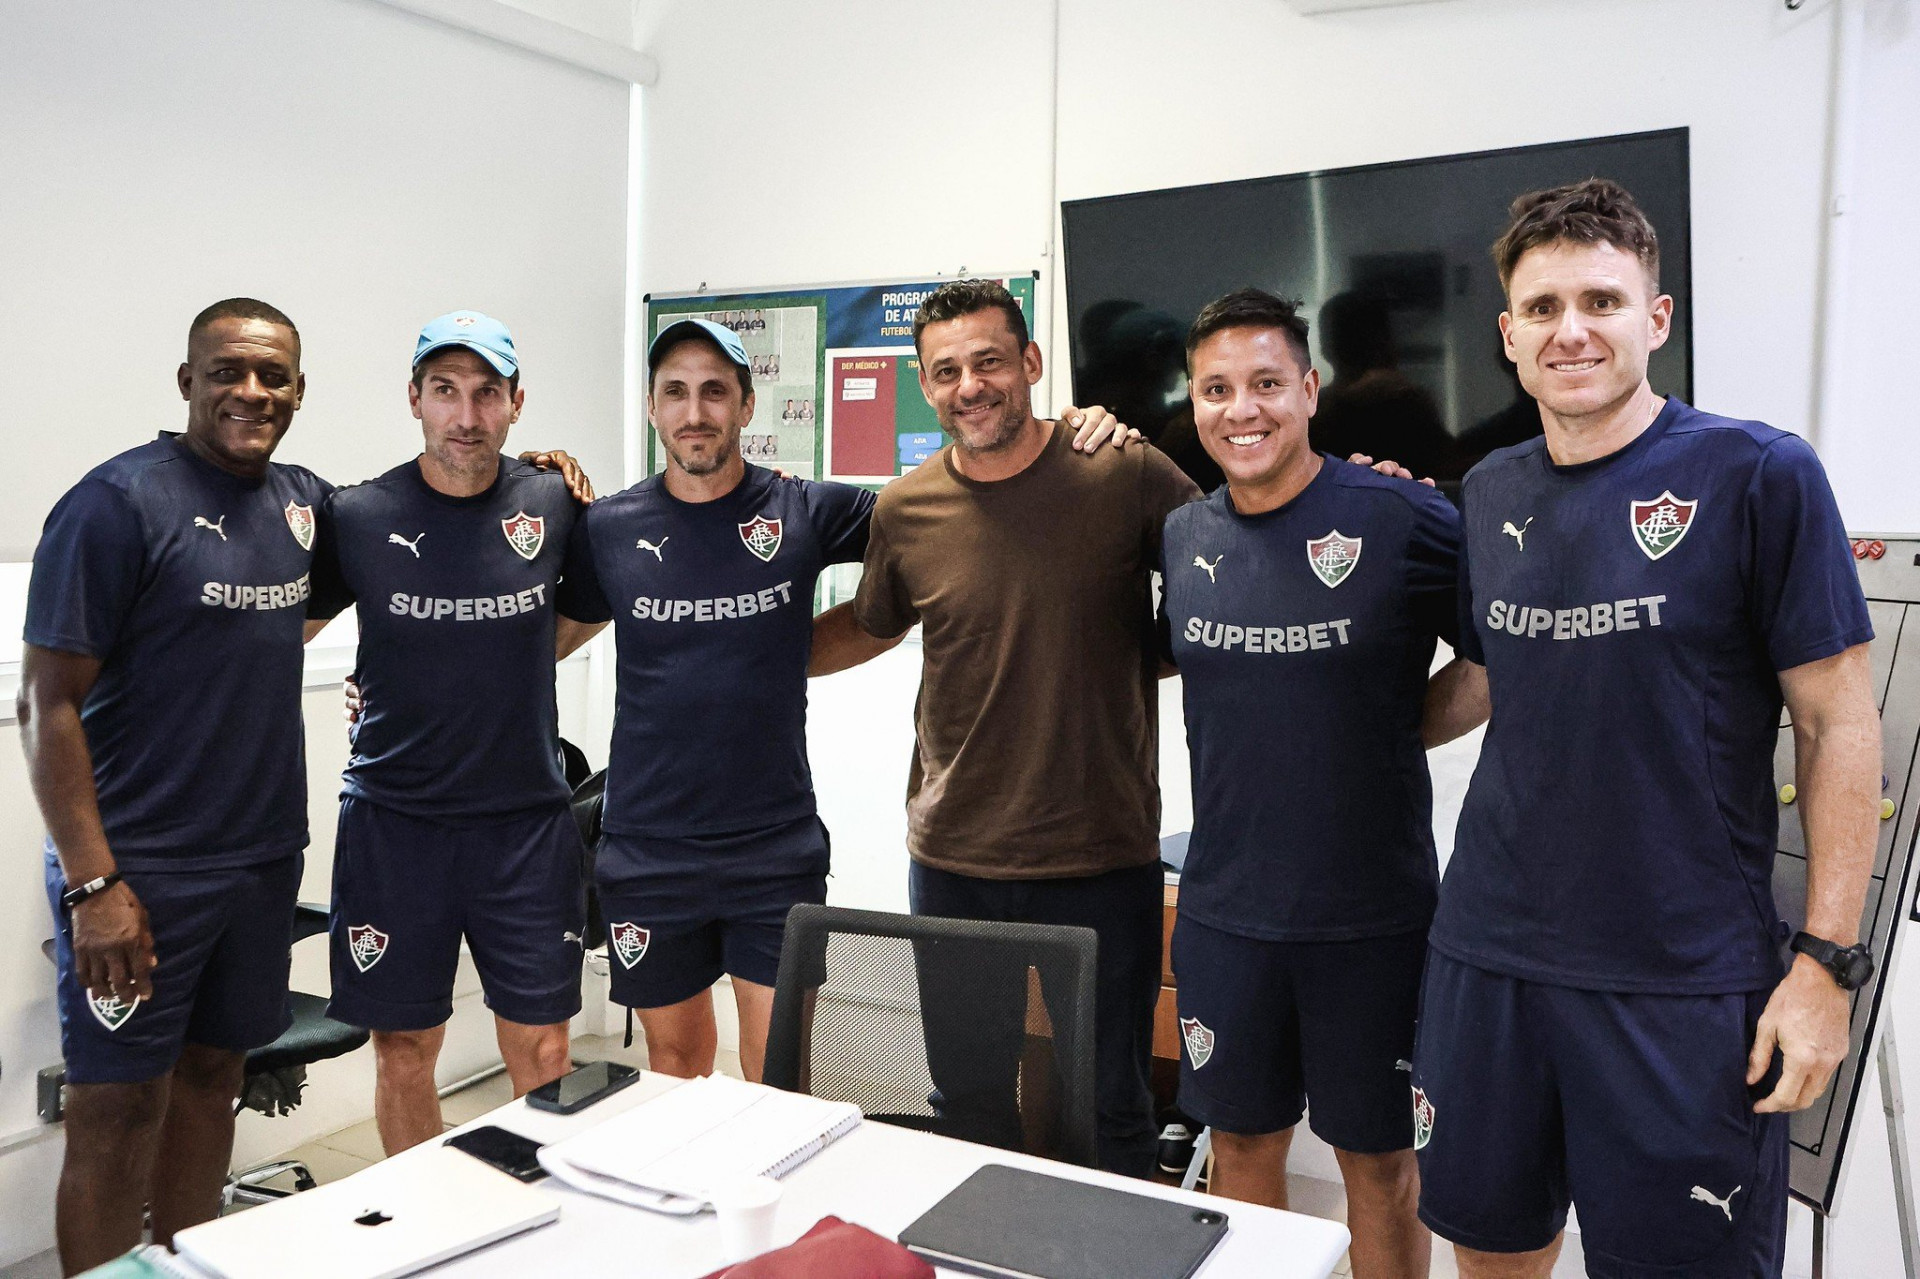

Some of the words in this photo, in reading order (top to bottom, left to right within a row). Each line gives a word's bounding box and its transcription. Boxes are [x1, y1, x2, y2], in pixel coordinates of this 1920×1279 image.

[882, 291, 933, 306] PROGRA
[885, 309, 900, 322] DE
[881, 326, 912, 336] FUTEBOL
[200, 571, 311, 611] SUPERBE
[389, 584, 546, 621] SUPERBET
[632, 581, 792, 622] SUPERBET
[1184, 617, 1352, 654] SUPERBET
[1487, 594, 1667, 641] SUPERBET
